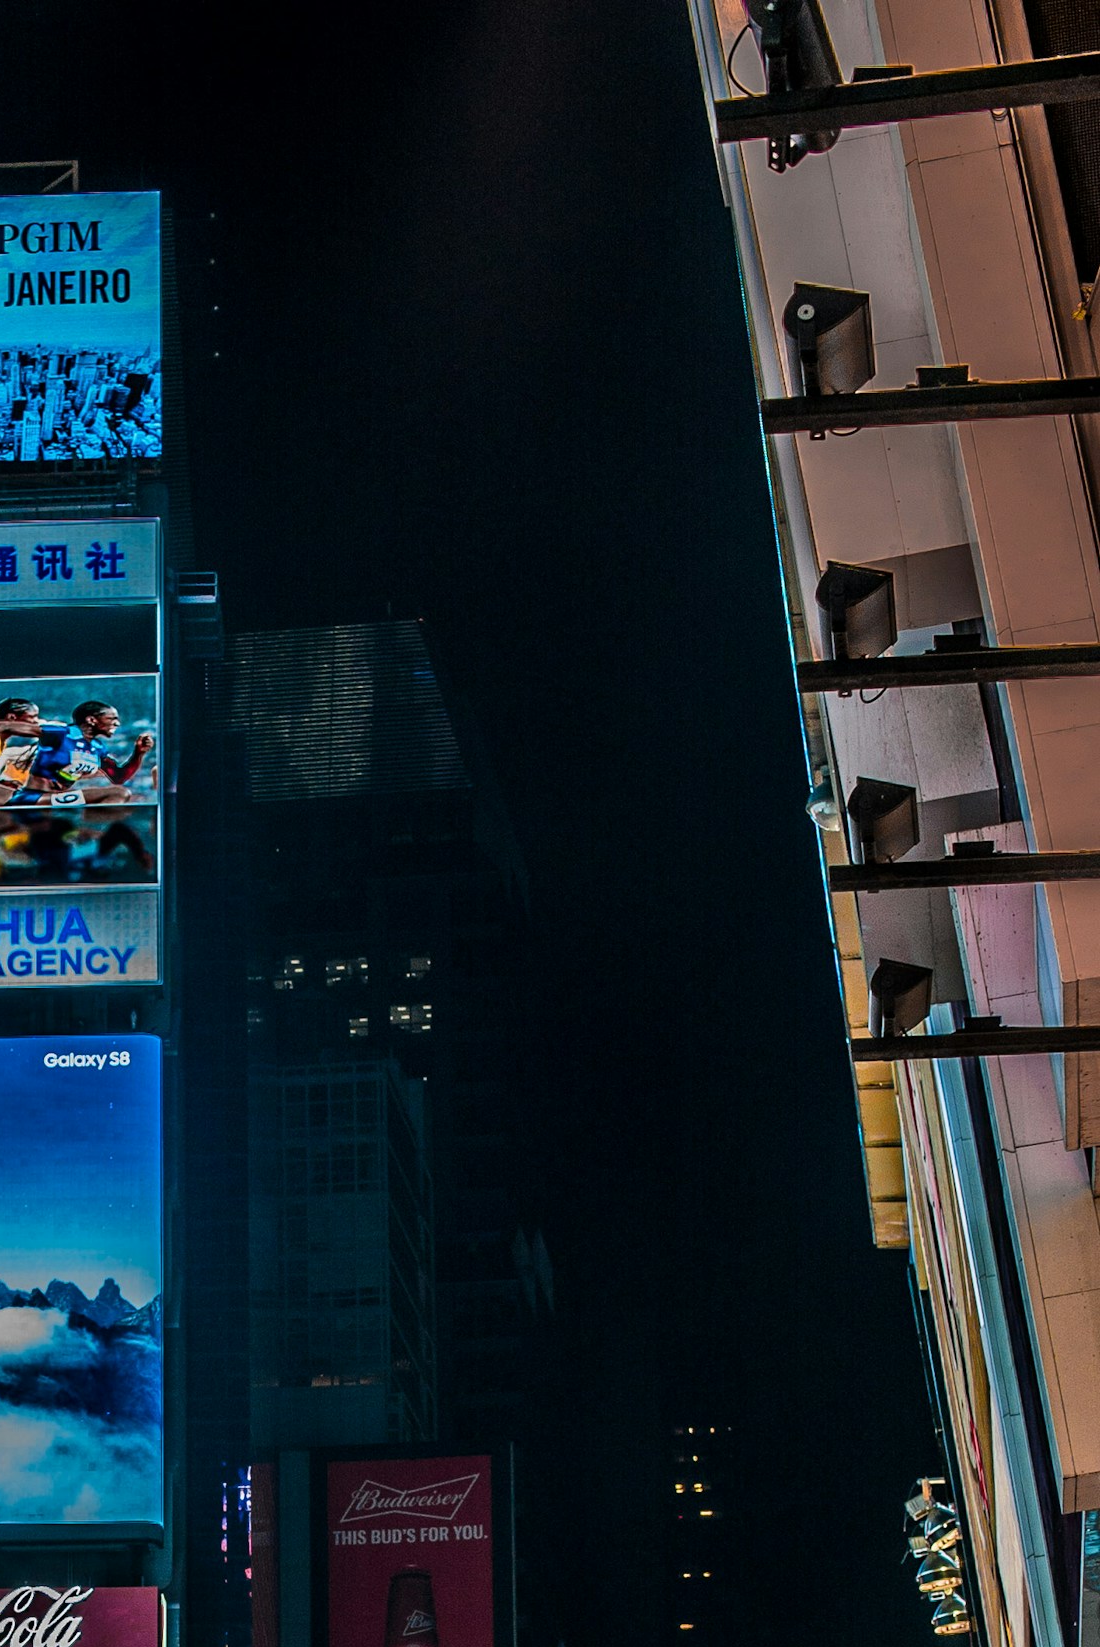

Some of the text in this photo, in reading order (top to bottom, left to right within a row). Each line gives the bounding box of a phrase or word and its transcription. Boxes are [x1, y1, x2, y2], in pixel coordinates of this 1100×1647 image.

[3, 268, 131, 307] JANEIRO
[43, 1051, 131, 1071] Galaxy S8
[351, 1489, 464, 1511] Budweiser
[333, 1525, 488, 1545] THIS BUD'S FOR YOU.
